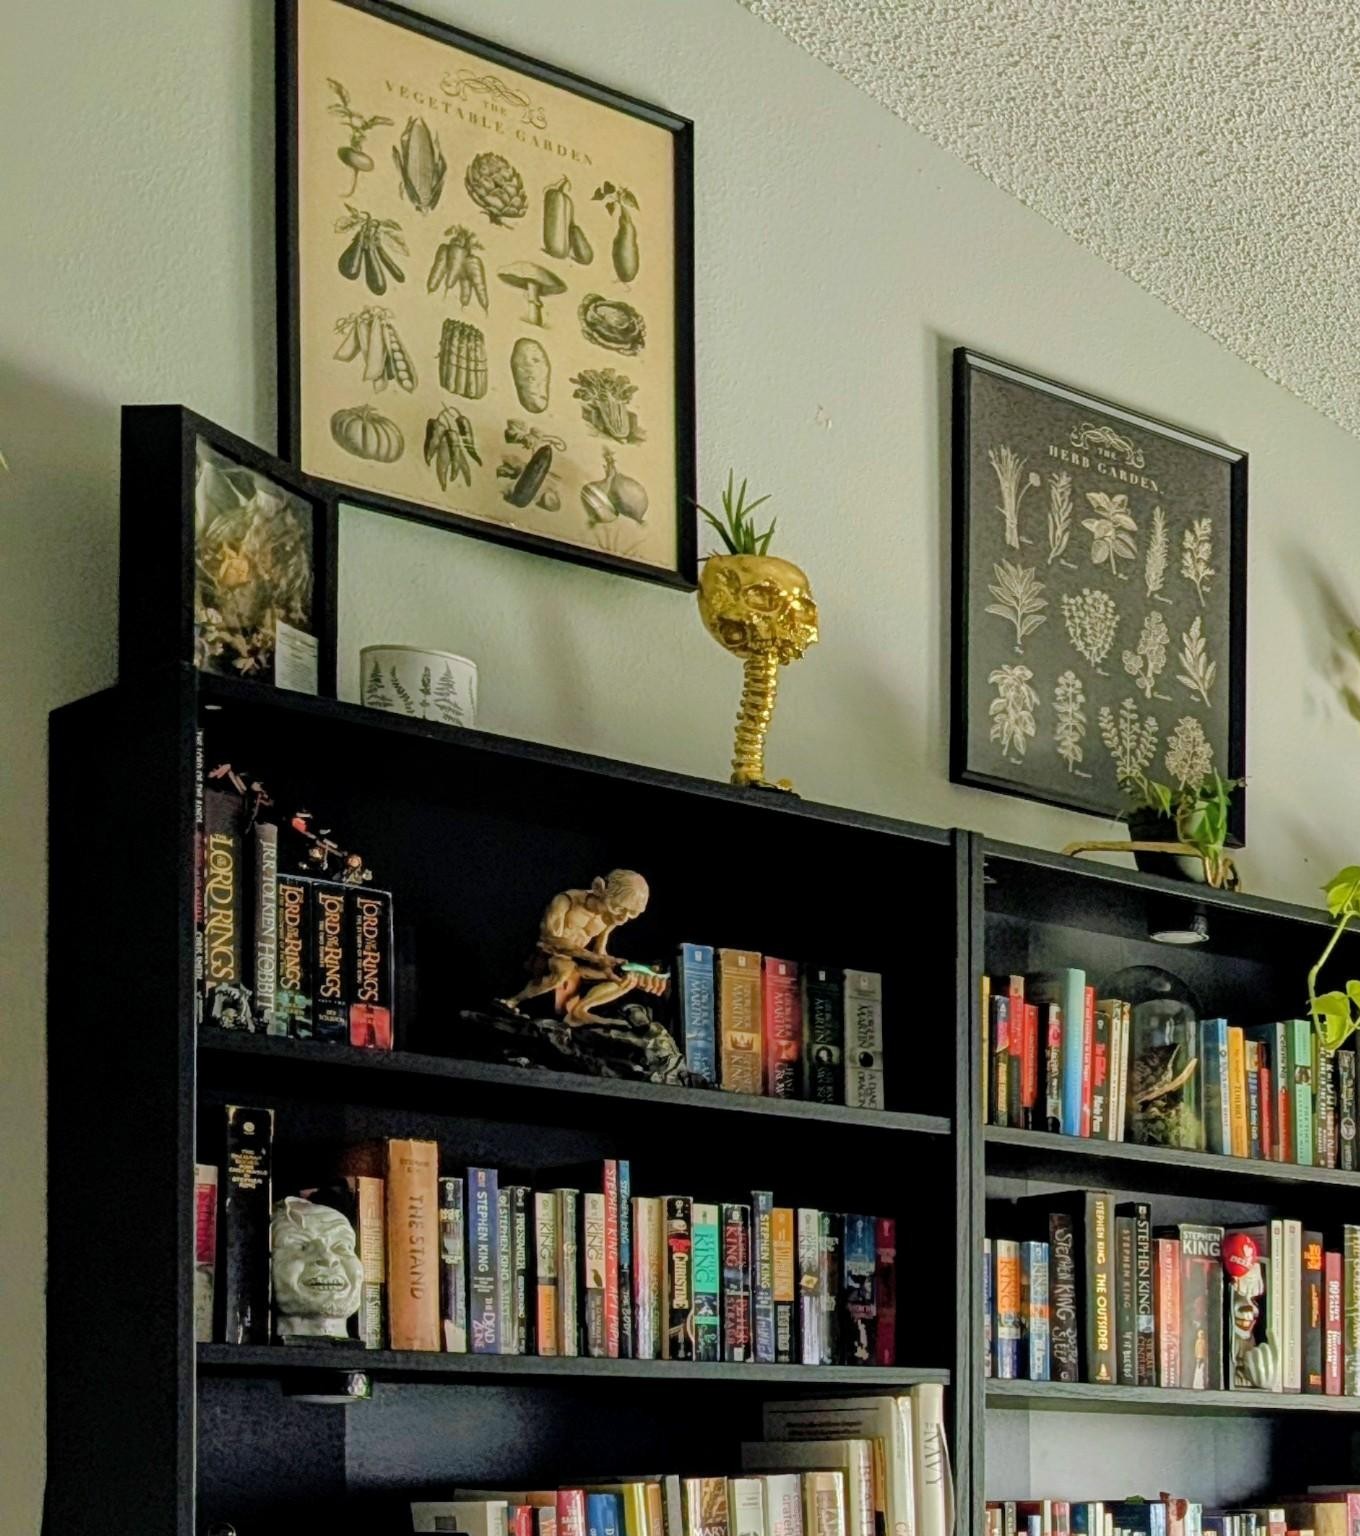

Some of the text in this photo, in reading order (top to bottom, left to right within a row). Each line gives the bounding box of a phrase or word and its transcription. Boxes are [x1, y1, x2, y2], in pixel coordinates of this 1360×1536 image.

[385, 80, 593, 166] VEGETABLE GARDEN
[483, 101, 507, 115] THE
[1049, 445, 1089, 468] HERB
[1098, 448, 1116, 460] THE
[206, 838, 234, 979] LORD RINGS
[257, 874, 275, 1012] TOLKIEN HOBBIT
[279, 884, 304, 990] LORD RINGS
[319, 892, 344, 998] LORD RINGS
[357, 897, 382, 1000] LORD RINGS
[690, 980, 701, 1025] MARTIN
[774, 992, 785, 1038] MARTIN
[857, 1005, 868, 1048] MARTIN
[477, 1191, 488, 1272] STEPHEN KING
[540, 1221, 553, 1260] KING
[587, 1221, 599, 1260] KING
[606, 1169, 618, 1261] STEPHEN KING
[1096, 1201, 1105, 1265] STEPHEN KING
[1183, 1231, 1220, 1241] STEPHEN
[408, 1196, 426, 1300] THE STAND
[694, 1232, 709, 1284] KING
[726, 1225, 739, 1267] KING
[759, 1214, 770, 1289] STEPHEN KING
[1123, 1229, 1131, 1309] STEPHEN KING
[1138, 1220, 1150, 1314] STEPHEN KING
[1183, 1240, 1221, 1257] KING
[1352, 1232, 1360, 1257] THE
[1000, 1260, 1012, 1308] KING
[1055, 1229, 1075, 1321] STEPHEN KING
[1329, 1280, 1339, 1293] 99
[484, 1312, 495, 1343] DEAD
[1096, 1273, 1108, 1351] THE OUTSIDER
[1053, 1327, 1067, 1362] SLEEP
[923, 1431, 941, 1488] NAVY
